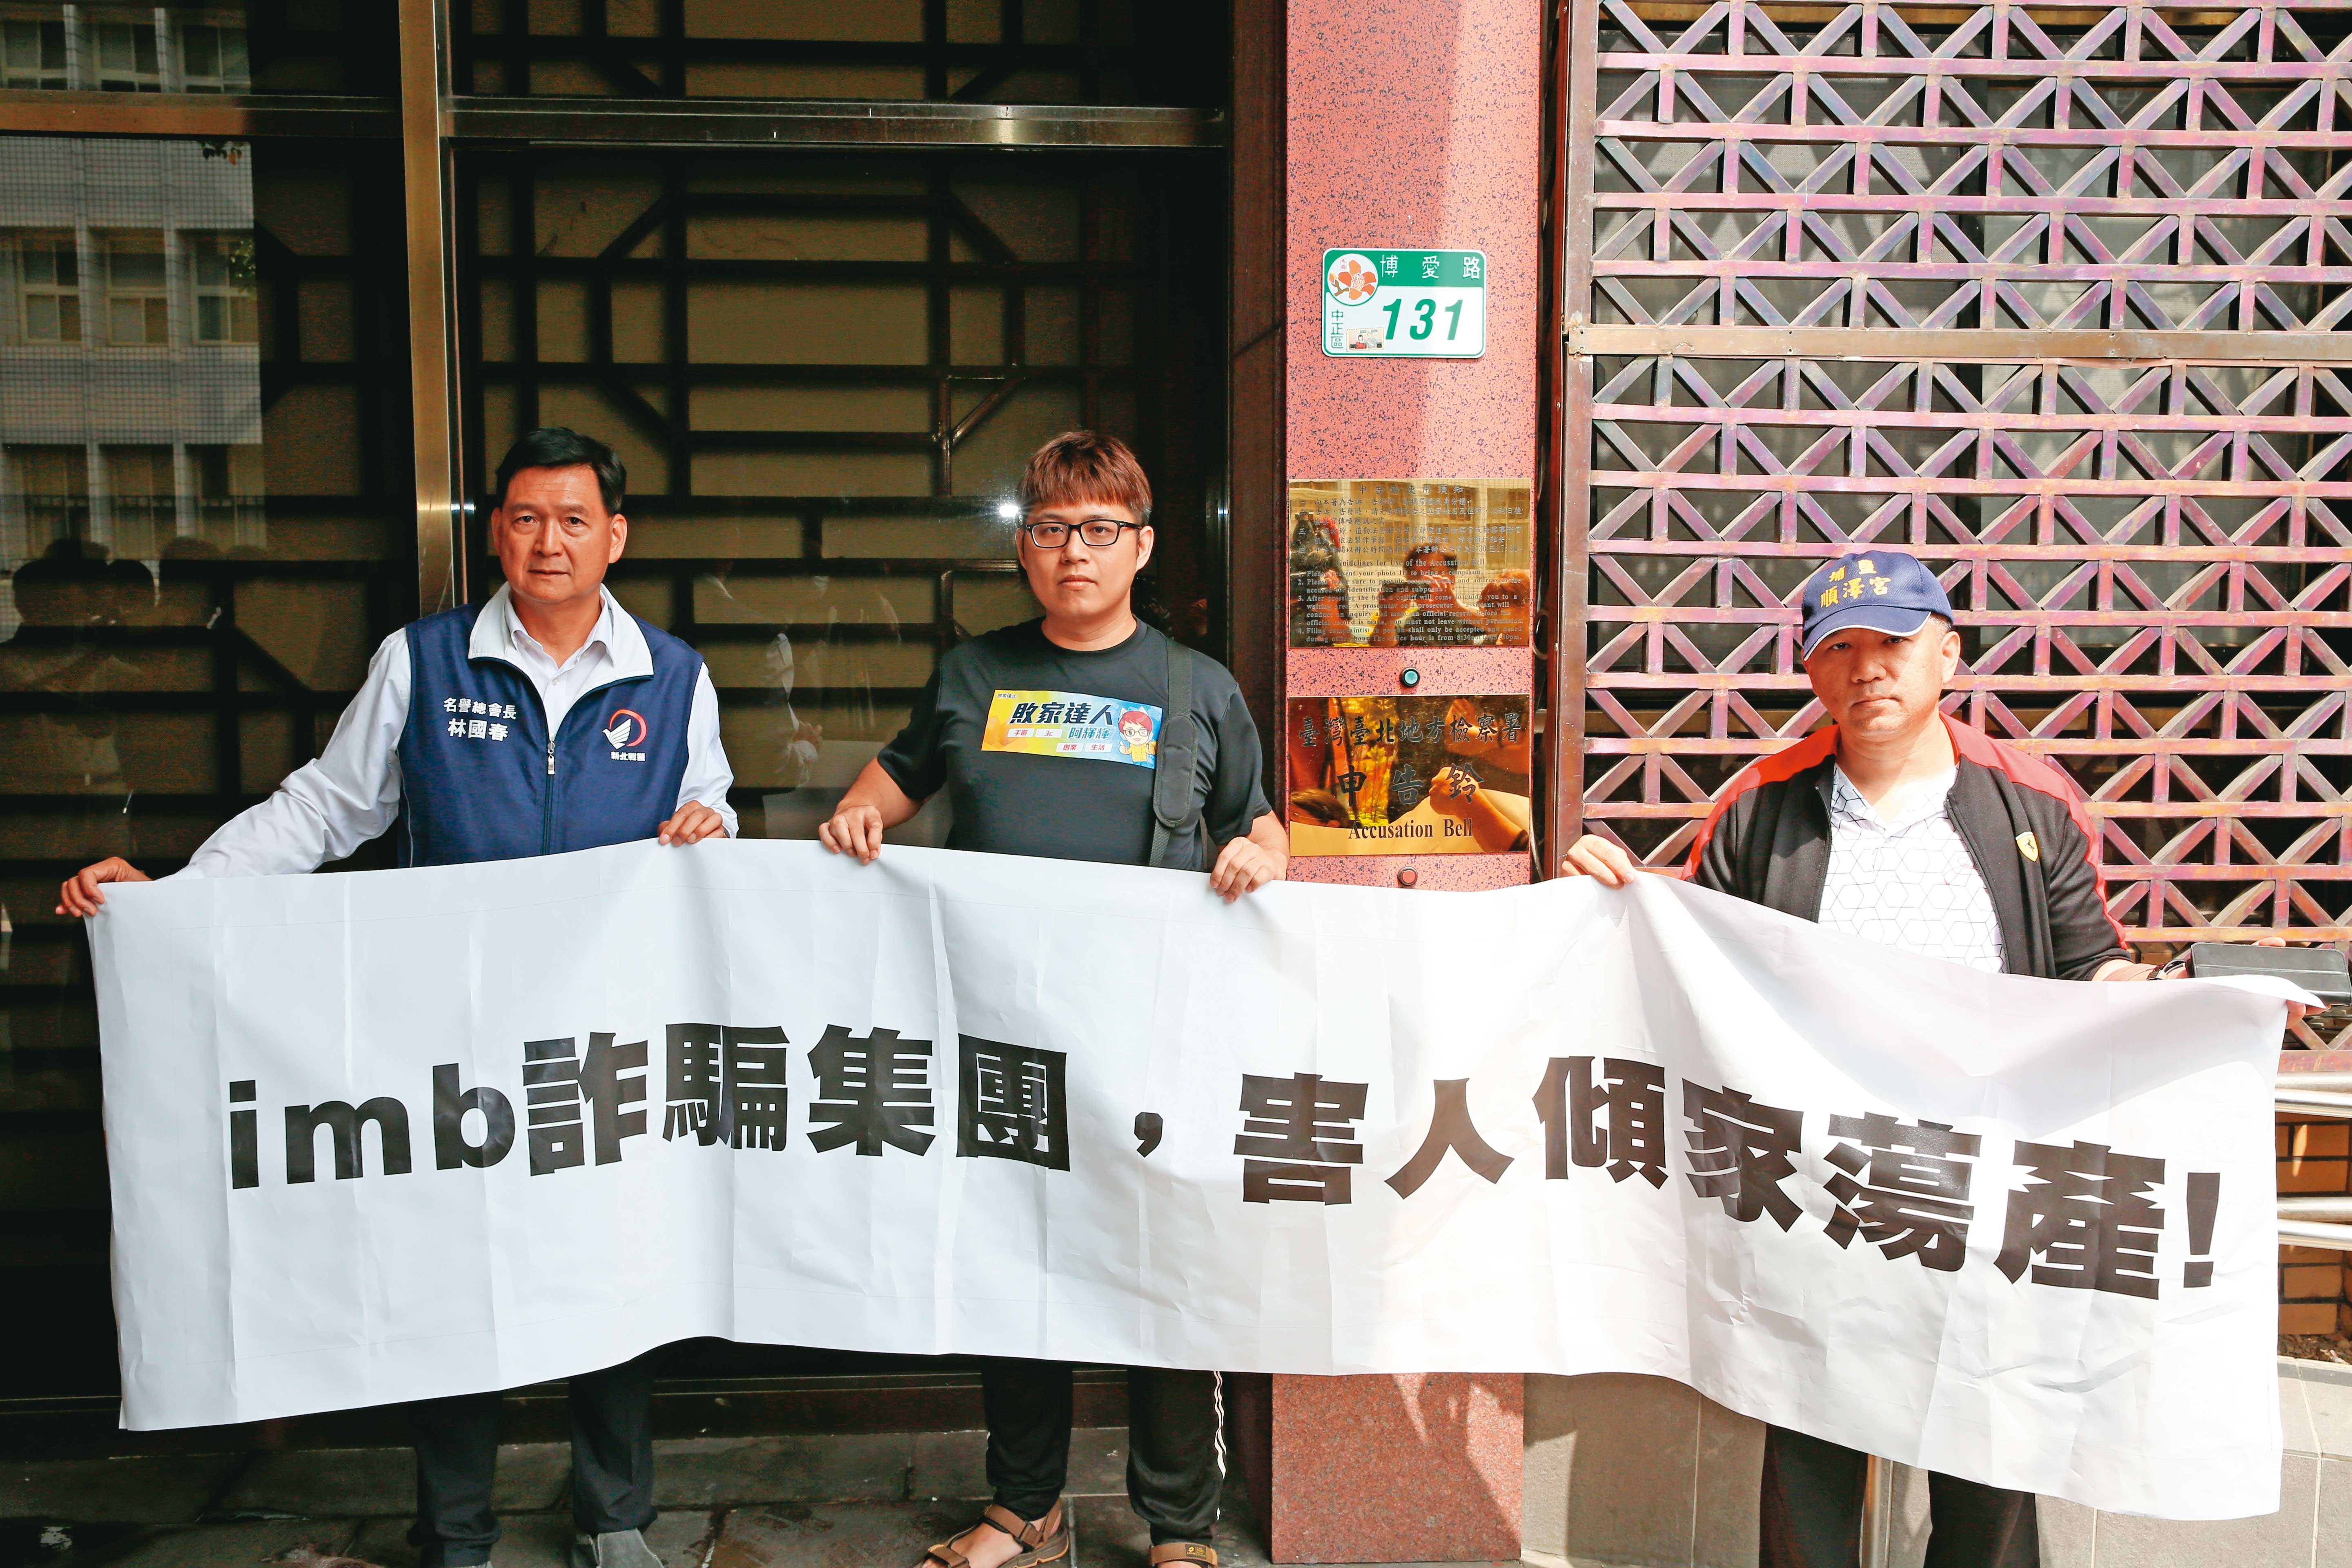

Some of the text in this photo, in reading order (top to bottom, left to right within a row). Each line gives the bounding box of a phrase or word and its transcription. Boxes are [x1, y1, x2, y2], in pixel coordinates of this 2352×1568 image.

[1380, 254, 1481, 280] 博愛路
[1331, 309, 1344, 348] 中正區
[1382, 298, 1463, 341] 131
[1359, 484, 1464, 495] 申告鈴使用須知
[1820, 576, 1892, 608] 順澤宮
[443, 697, 517, 720] 名譽總會長
[1009, 702, 1113, 726] 敗家達人
[448, 718, 509, 742] 林國春
[1068, 727, 1111, 740] 阿輝輝
[1298, 712, 1521, 748] 臺灣臺北地方檢察署
[1337, 762, 1484, 807] 申告鈴
[1349, 818, 1473, 840] Accusation Bell
